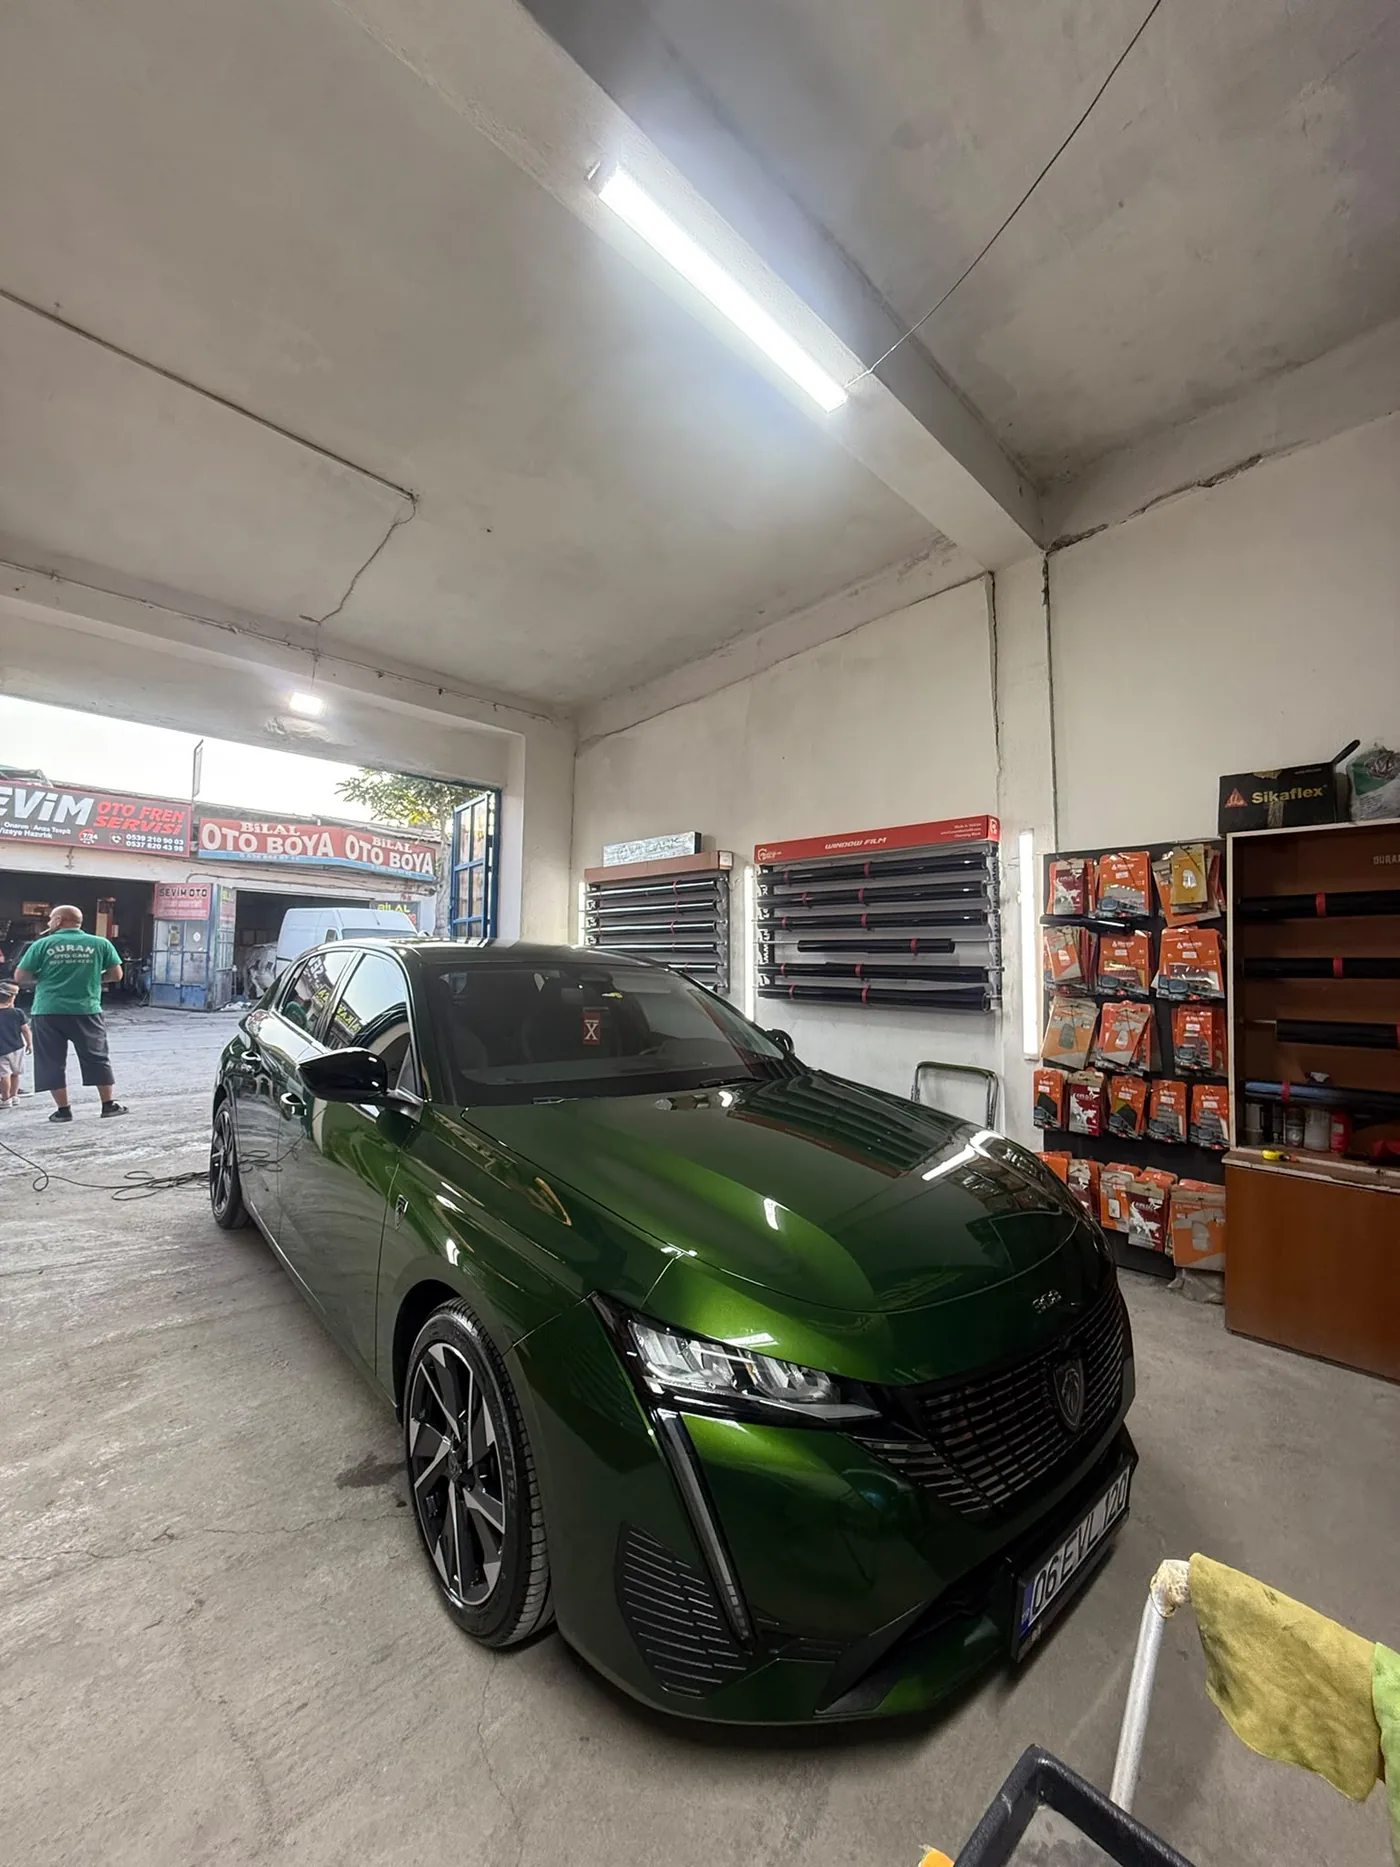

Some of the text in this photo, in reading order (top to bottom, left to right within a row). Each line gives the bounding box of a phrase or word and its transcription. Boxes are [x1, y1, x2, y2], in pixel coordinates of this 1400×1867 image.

[1251, 786, 1324, 804] Sikaflex
[97, 801, 186, 823] OTO FREN
[126, 833, 146, 842] 0539
[201, 822, 335, 857] OTO BOYA
[824, 836, 887, 850] WINDOW FILM
[345, 834, 384, 865] OTO
[389, 851, 434, 875] BOYA
[1373, 854, 1400, 865] DURA
[189, 888, 208, 897] OTO
[46, 944, 95, 956] DURAN
[1032, 1555, 1059, 1615] 06
[1102, 1471, 1127, 1530] 120
